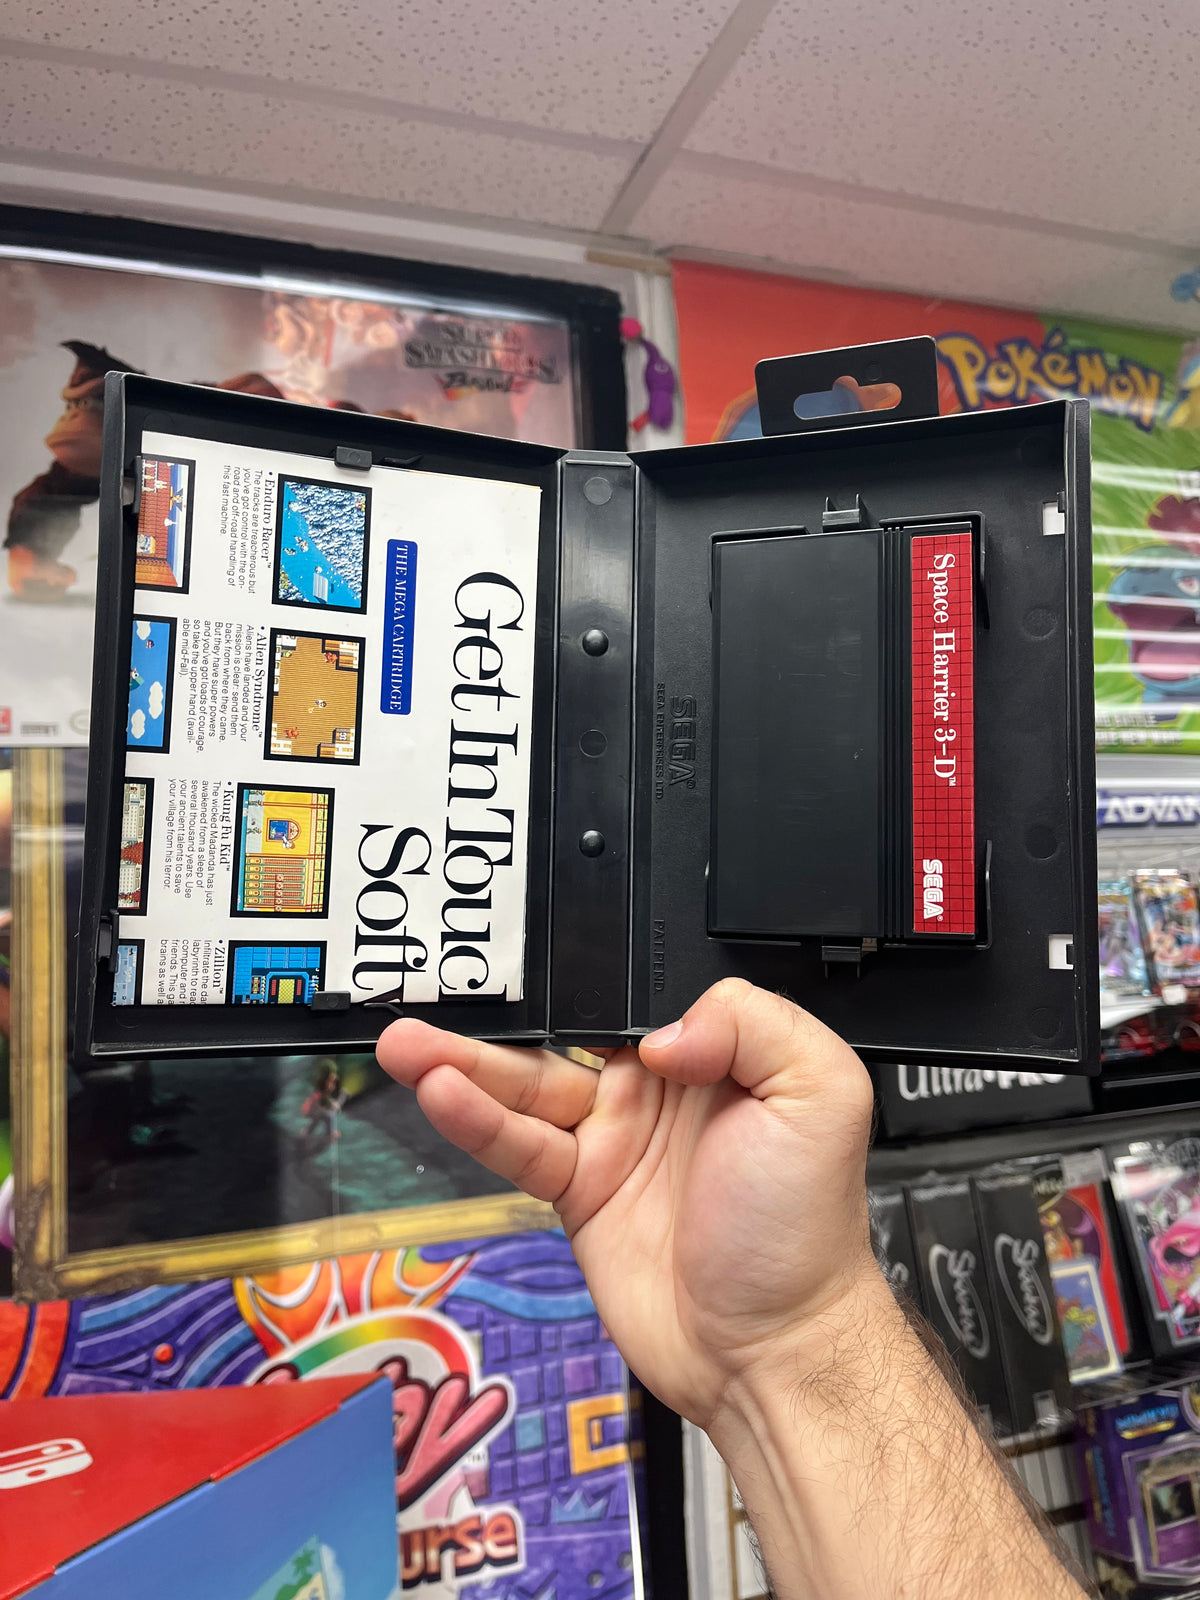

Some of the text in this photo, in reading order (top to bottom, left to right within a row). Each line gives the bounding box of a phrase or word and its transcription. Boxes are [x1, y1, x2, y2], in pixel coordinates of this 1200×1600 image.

[223, 465, 231, 480] this
[233, 467, 242, 486] road
[254, 470, 263, 485] The
[222, 481, 231, 497] fast
[232, 487, 241, 504] and
[252, 487, 261, 512] tracks
[240, 496, 250, 510] got
[263, 479, 275, 524] Enduro
[240, 511, 250, 541] control
[226, 540, 238, 576] handling
[240, 542, 248, 559] with
[249, 529, 259, 578] treacherous
[239, 560, 247, 574] the
[227, 578, 236, 586] of
[248, 580, 256, 594] but
[928, 553, 955, 623] Space
[182, 618, 191, 637] able
[193, 619, 200, 630] so
[203, 620, 213, 637] and
[224, 623, 234, 644] back
[390, 545, 408, 709] THE MEGA CARTRIDGE
[192, 631, 201, 650] take
[234, 624, 244, 656] mission
[255, 633, 267, 665] Alien
[451, 572, 524, 711] Get
[191, 651, 200, 665] the
[223, 646, 233, 666] from
[188, 666, 198, 693] upper
[199, 666, 209, 680] got
[207, 622, 223, 737] But they have super powers
[221, 668, 231, 694] where
[238, 624, 255, 742] Aliens have landed and your
[933, 629, 955, 721] Harrier
[200, 681, 209, 705] loads
[231, 692, 240, 713] send
[657, 683, 665, 709] SEGA
[188, 694, 198, 716] hand
[199, 706, 208, 715] of
[218, 696, 229, 715] they
[230, 714, 239, 736] them
[656, 713, 664, 777] ENTERPRISES
[447, 719, 518, 807] In
[167, 779, 177, 798] your
[190, 780, 200, 811] several
[200, 780, 210, 824] awakened
[220, 790, 234, 822] Kung
[165, 799, 177, 827] village
[166, 829, 175, 849] from
[174, 779, 188, 894] your ancient talents to save
[187, 812, 197, 852] thousand
[198, 826, 208, 845] from
[221, 826, 232, 839] Fu
[204, 781, 221, 906] The wicked Madanda has just
[165, 850, 174, 863] his
[195, 854, 206, 878] sleep
[185, 882, 194, 899] Use
[196, 880, 205, 888] of
[159, 939, 169, 967] brains
[180, 939, 189, 981] computer
[190, 940, 201, 976] labyrinth
[202, 940, 212, 974] Infiltrate
[158, 968, 166, 979] as
[168, 973, 179, 992] This
[191, 978, 198, 987] to
[201, 976, 210, 989] the
[157, 980, 167, 998] well
[179, 983, 188, 1000] and
